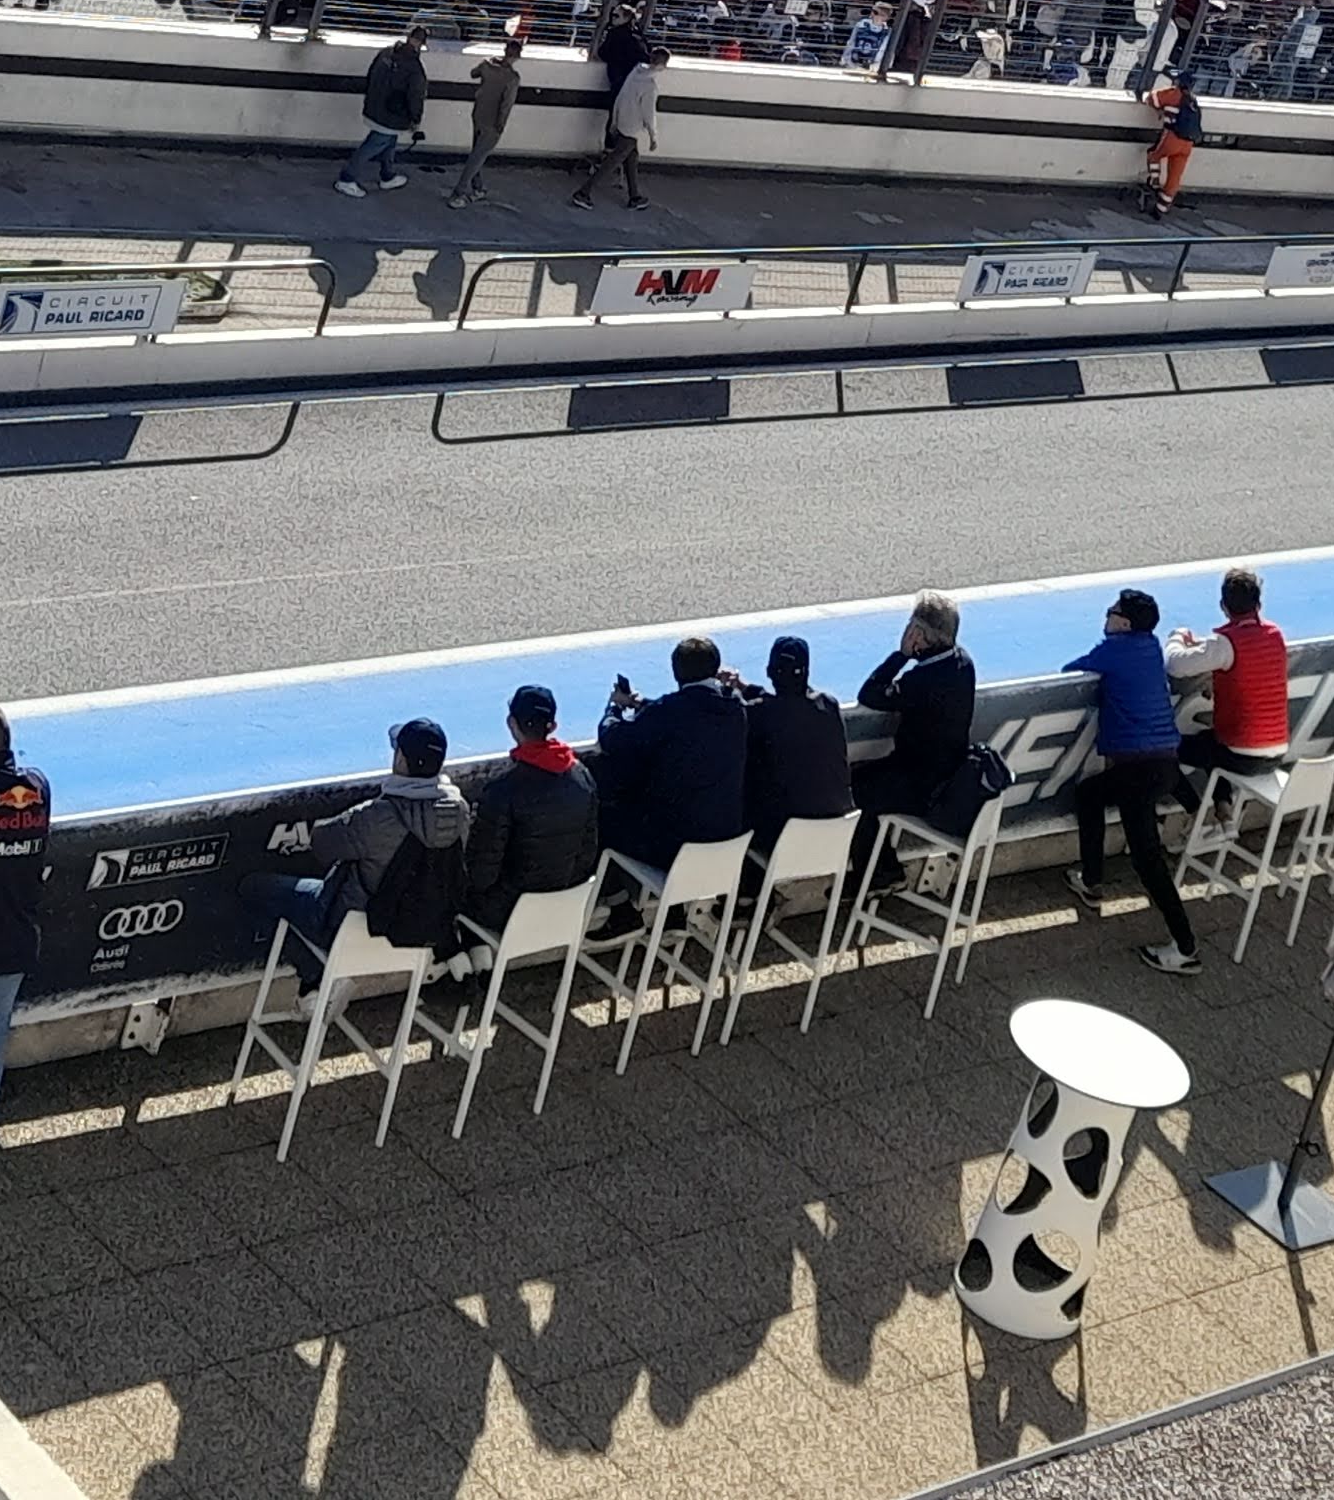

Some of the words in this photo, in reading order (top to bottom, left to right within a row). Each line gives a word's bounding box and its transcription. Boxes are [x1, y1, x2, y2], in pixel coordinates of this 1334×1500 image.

[634, 268, 721, 296] HVM
[49, 295, 151, 309] CIRCUIT
[44, 311, 84, 325] PAUL
[89, 309, 145, 323] RICARD
[133, 841, 220, 862] CIRCUIT
[129, 862, 163, 878] PAUL
[166, 853, 216, 871] RICARD
[93, 944, 130, 960] Audi
